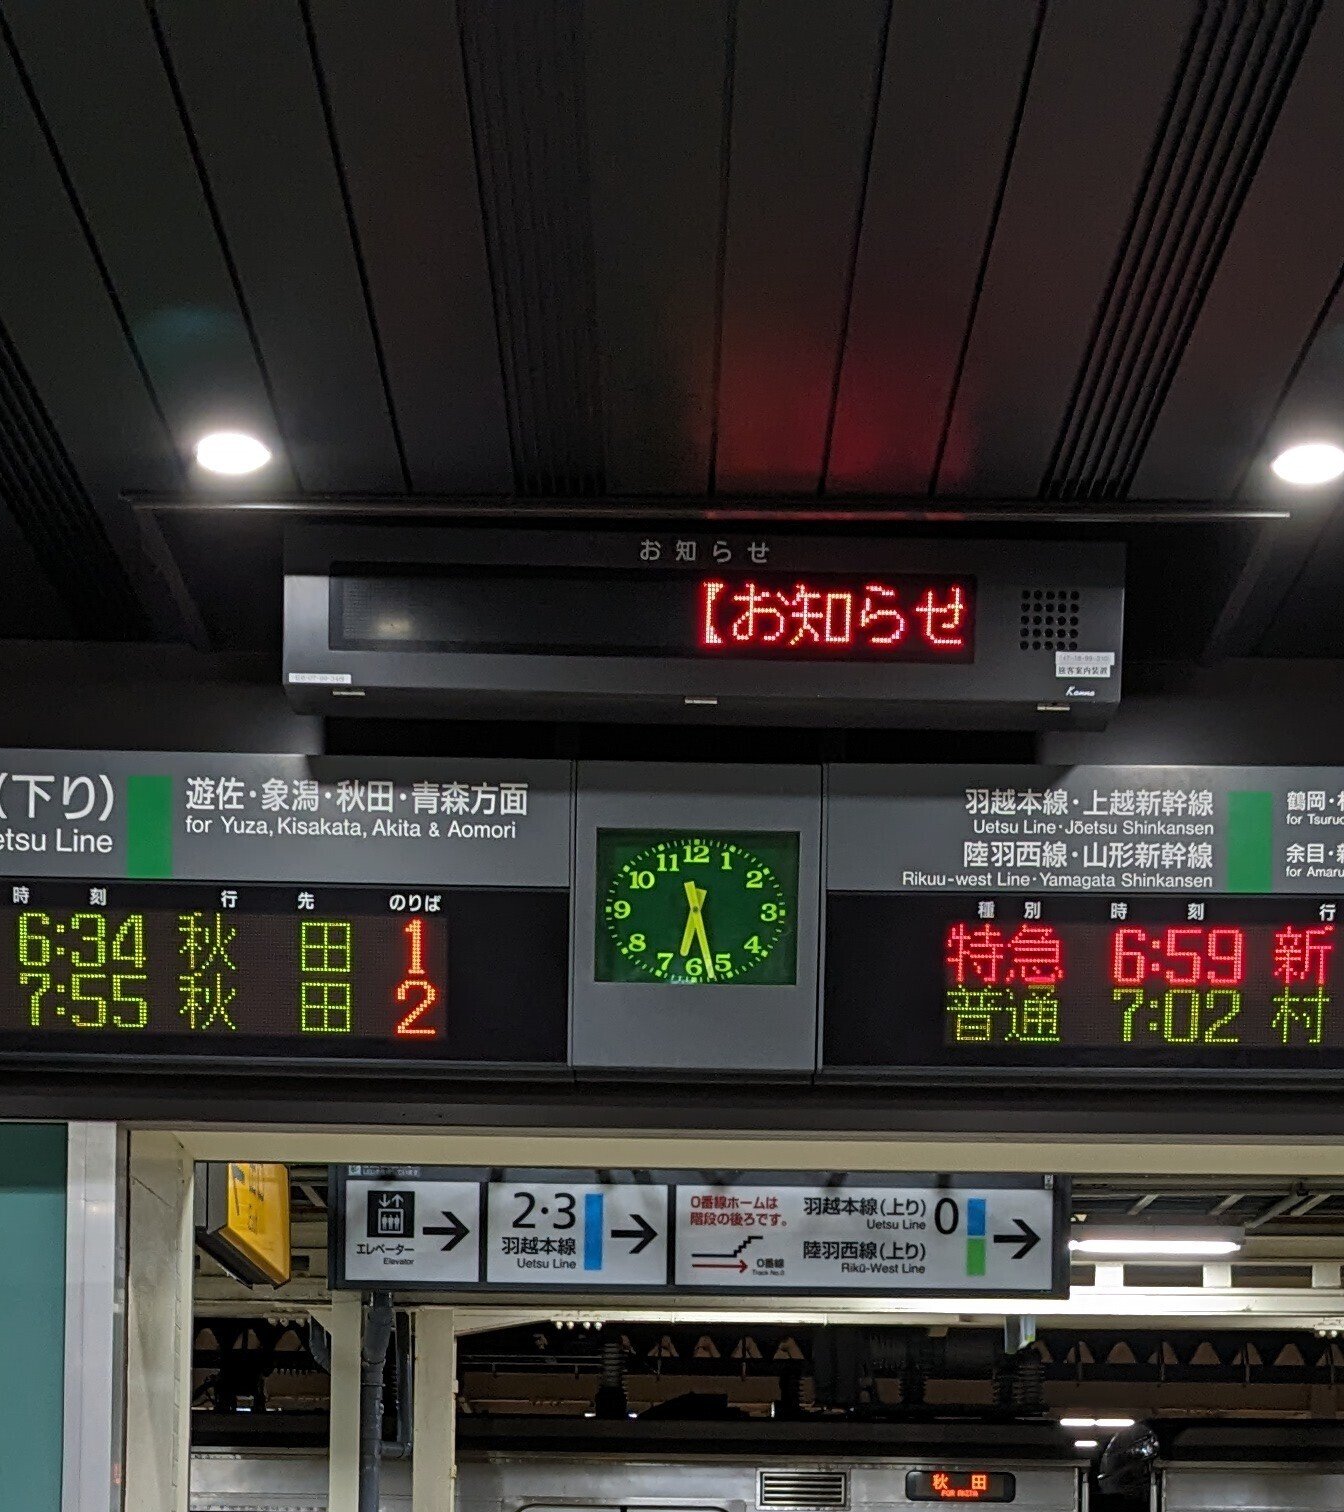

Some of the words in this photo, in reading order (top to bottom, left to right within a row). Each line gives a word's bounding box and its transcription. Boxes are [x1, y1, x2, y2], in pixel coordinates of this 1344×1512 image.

[640, 539, 771, 564] お知らせ
[965, 789, 1214, 817] 羽越本線・上越新幹線
[185, 816, 212, 834] for
[221, 816, 273, 838] Yuza,
[277, 818, 368, 838] Kisakata,
[373, 820, 422, 838] Akita
[430, 822, 440, 838] &
[448, 821, 516, 840] Aomori
[973, 820, 1015, 836] Uetsu
[1122, 819, 1214, 837] Shinkansen
[1286, 813, 1302, 826] for
[56, 827, 112, 854] Line
[657, 854, 679, 871] 11
[683, 845, 709, 863] 12
[721, 852, 732, 870] 1
[963, 842, 1214, 869] 陸羽西線・山形新幹線
[629, 871, 655, 889] 10
[746, 871, 763, 888] 2
[902, 872, 992, 888] Rikuu-west
[1121, 872, 1213, 888] Shinkansen
[1286, 865, 1302, 879] for
[390, 894, 441, 913] のりば
[614, 900, 631, 919] 9
[760, 903, 778, 921] 3
[18, 913, 146, 969] 6:34
[404, 918, 423, 975] 1
[628, 934, 646, 952] 8
[744, 936, 761, 953] 4
[657, 953, 673, 971] 7
[715, 954, 731, 971] 5
[947, 926, 1064, 985] 特急
[1114, 928, 1245, 985] 6:59
[685, 958, 702, 976] 6
[18, 973, 148, 1029] 7:55
[395, 980, 437, 1035] 2
[947, 985, 1061, 1044] 普通
[1114, 988, 1239, 1044] 7:02
[803, 1197, 926, 1217] 羽越本線(上り)
[867, 1219, 900, 1230] Uetsu
[903, 1220, 926, 1230] Line
[934, 1198, 959, 1235] 0
[356, 1243, 414, 1255] エレベーター
[502, 1237, 576, 1255] 羽越本線
[803, 1242, 926, 1261] 陸羽西線(上り)
[383, 1258, 414, 1266] Elevator
[517, 1257, 550, 1269] Uetsu
[553, 1258, 576, 1269] Line
[901, 1263, 925, 1274] Line
